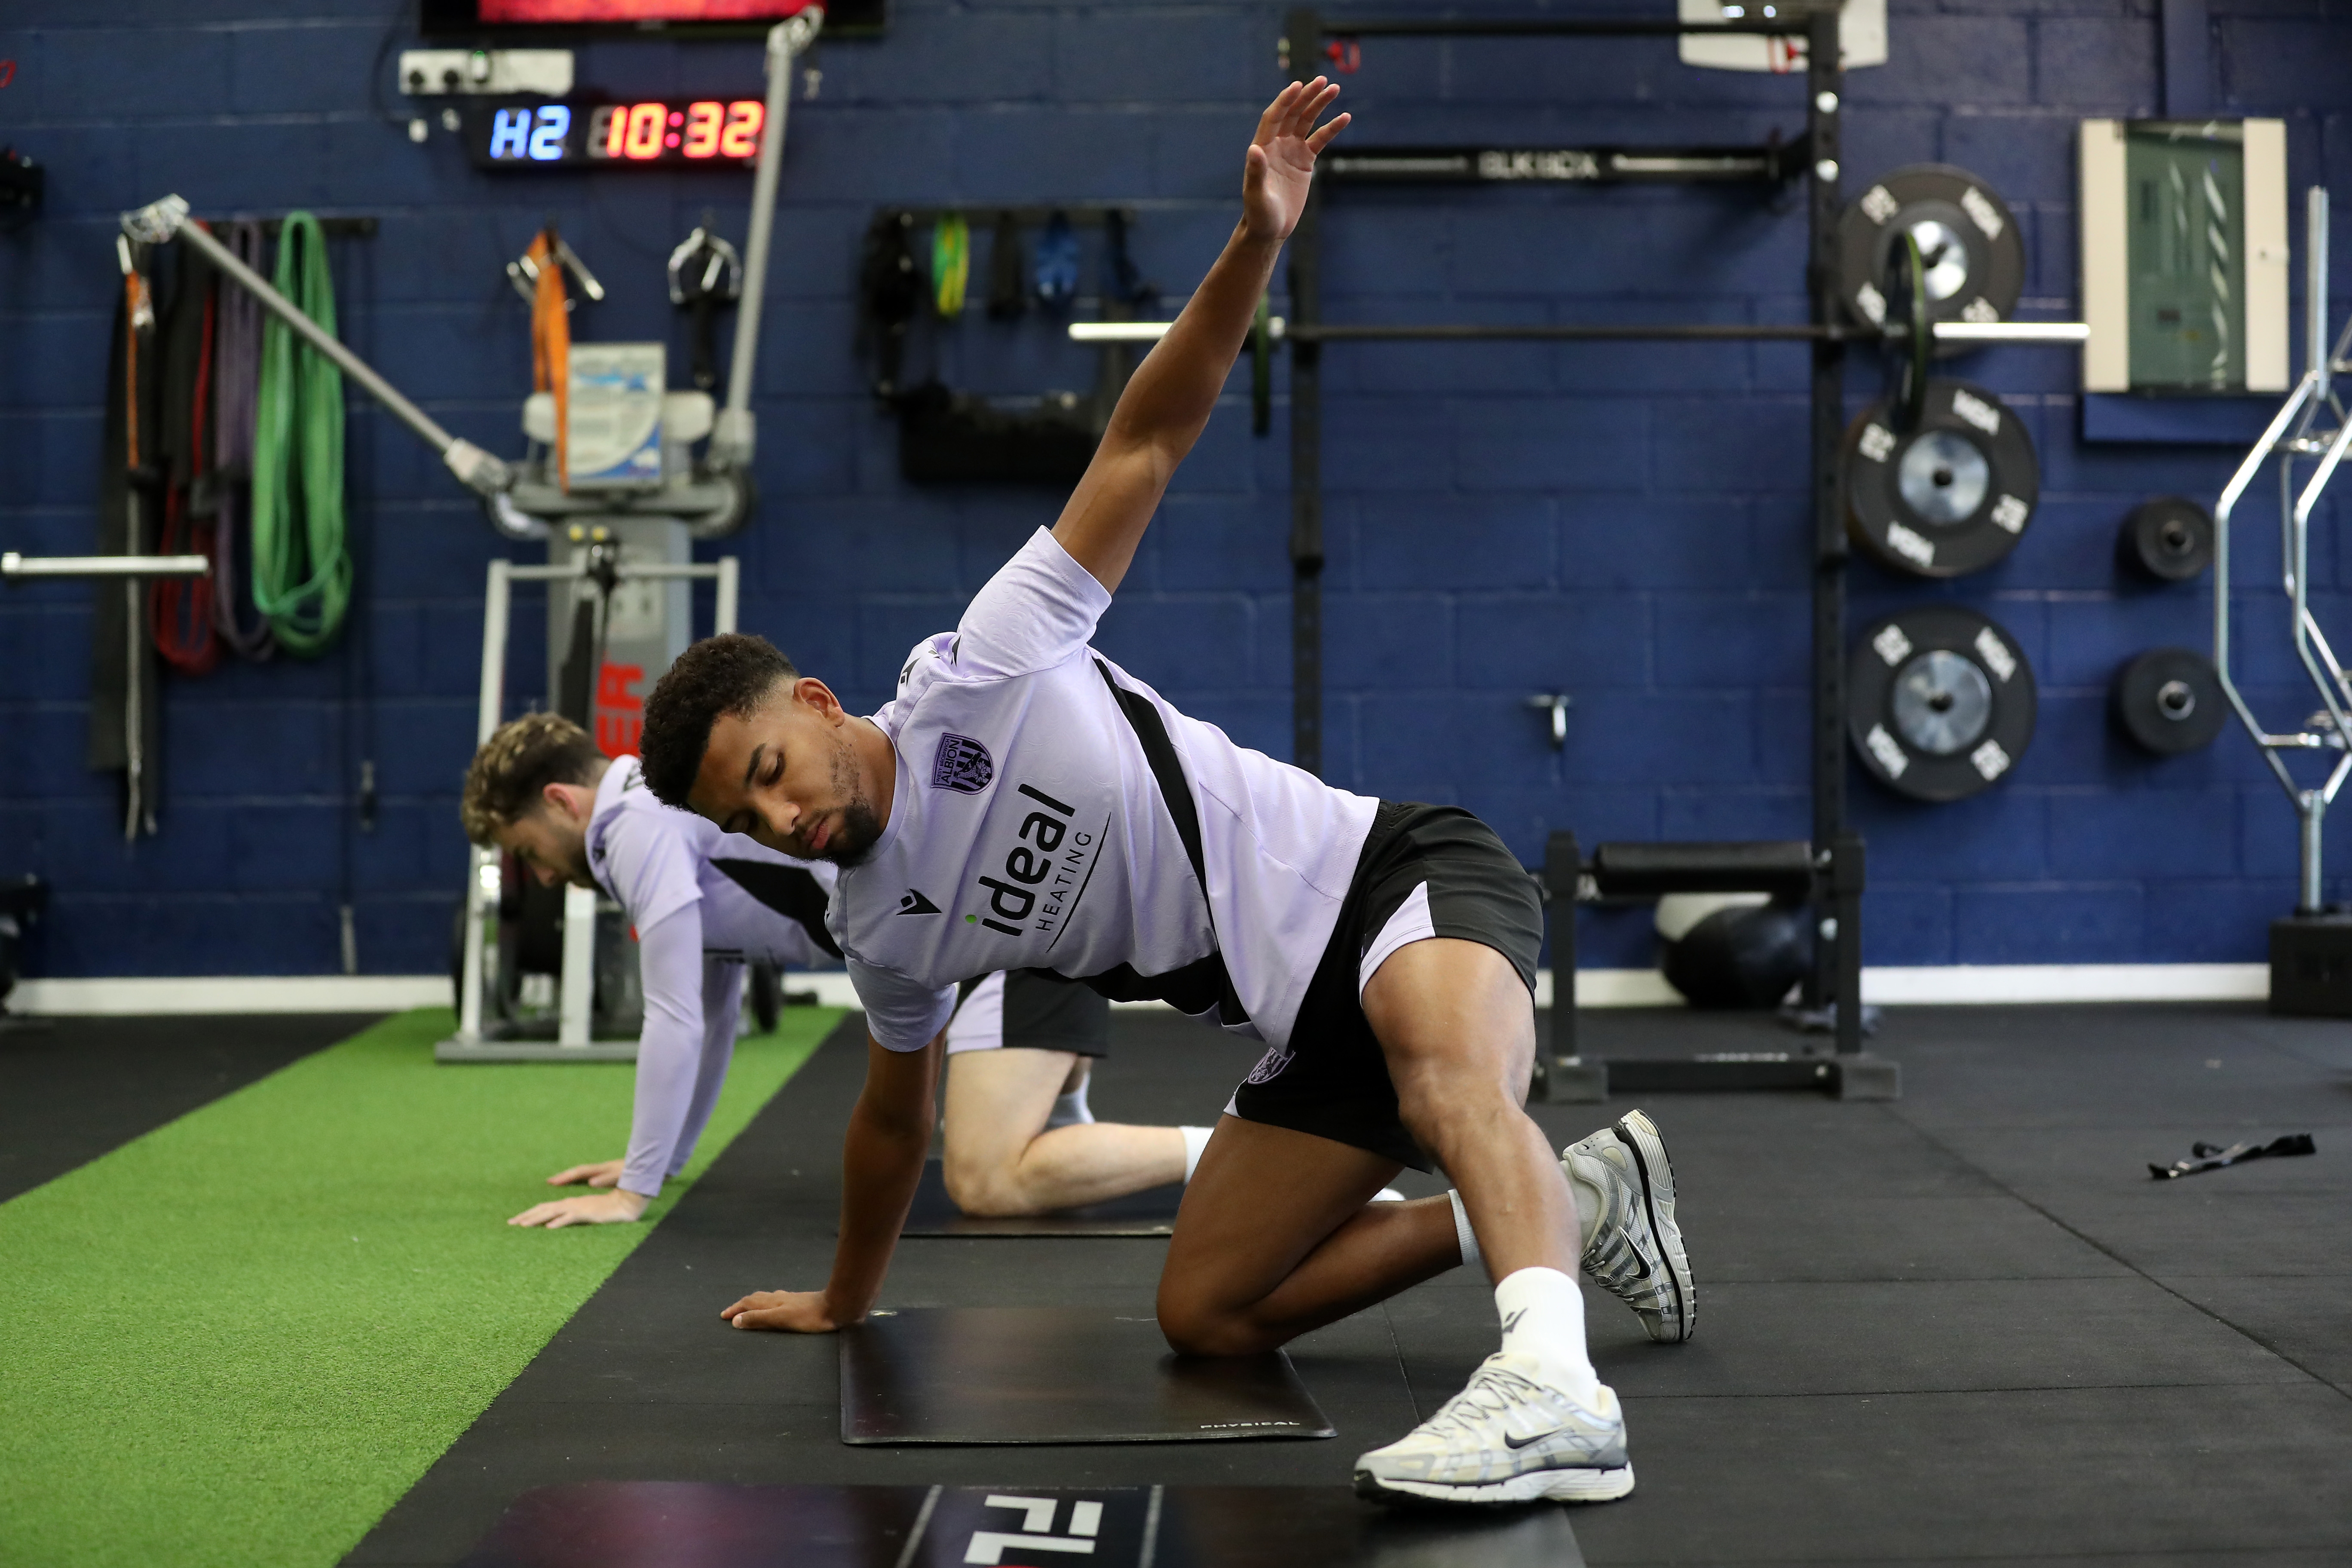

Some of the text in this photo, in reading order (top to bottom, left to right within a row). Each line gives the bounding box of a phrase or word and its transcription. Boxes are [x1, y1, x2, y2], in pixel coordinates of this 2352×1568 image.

[489, 100, 765, 161] H2 10:32
[939, 739, 950, 767] BROMWICH
[941, 739, 960, 784] ALBION
[965, 783, 1075, 937] ideal
[1035, 831, 1093, 931] HEATING
[1200, 1421, 1301, 1429] PHYSICAL
